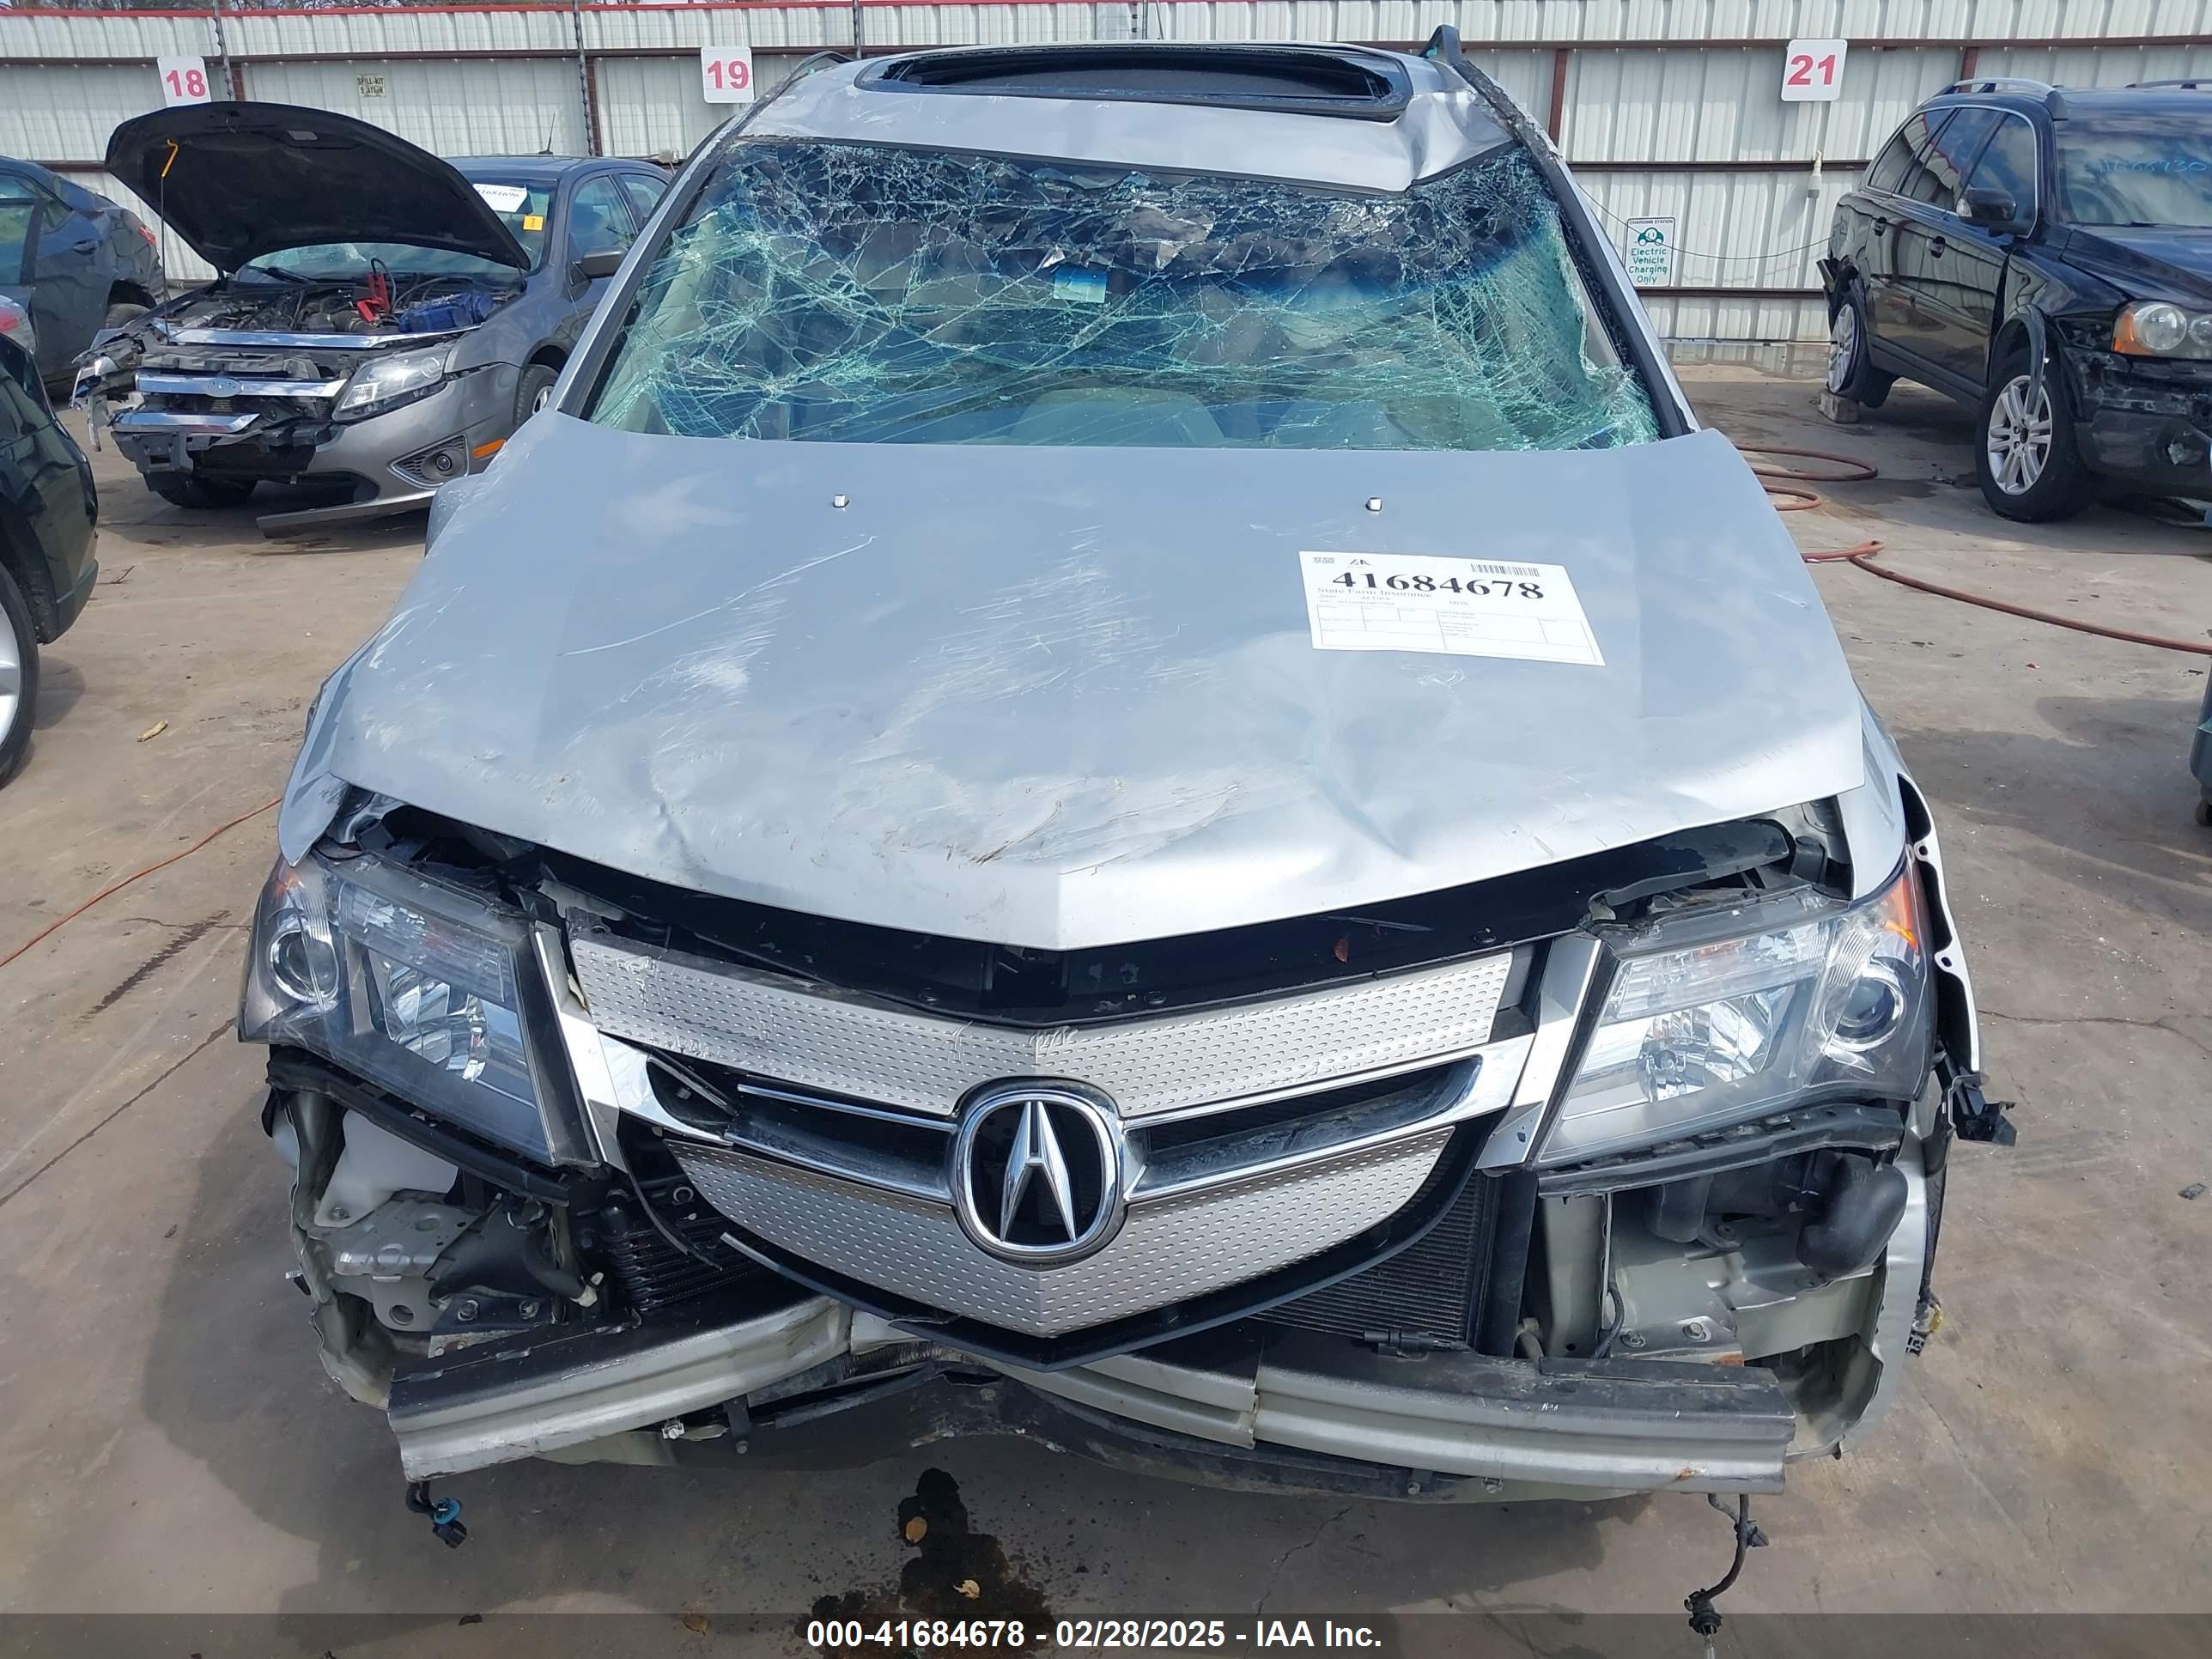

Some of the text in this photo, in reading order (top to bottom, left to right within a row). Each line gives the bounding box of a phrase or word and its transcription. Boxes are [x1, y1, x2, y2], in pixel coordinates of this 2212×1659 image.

[707, 60, 750, 89] 19
[1787, 54, 1836, 85] 21
[166, 70, 206, 97] 18
[1631, 247, 1667, 256] Electric
[1628, 265, 1668, 275] Charging
[1637, 275, 1657, 285] Only
[1332, 572, 1544, 599] 41684678
